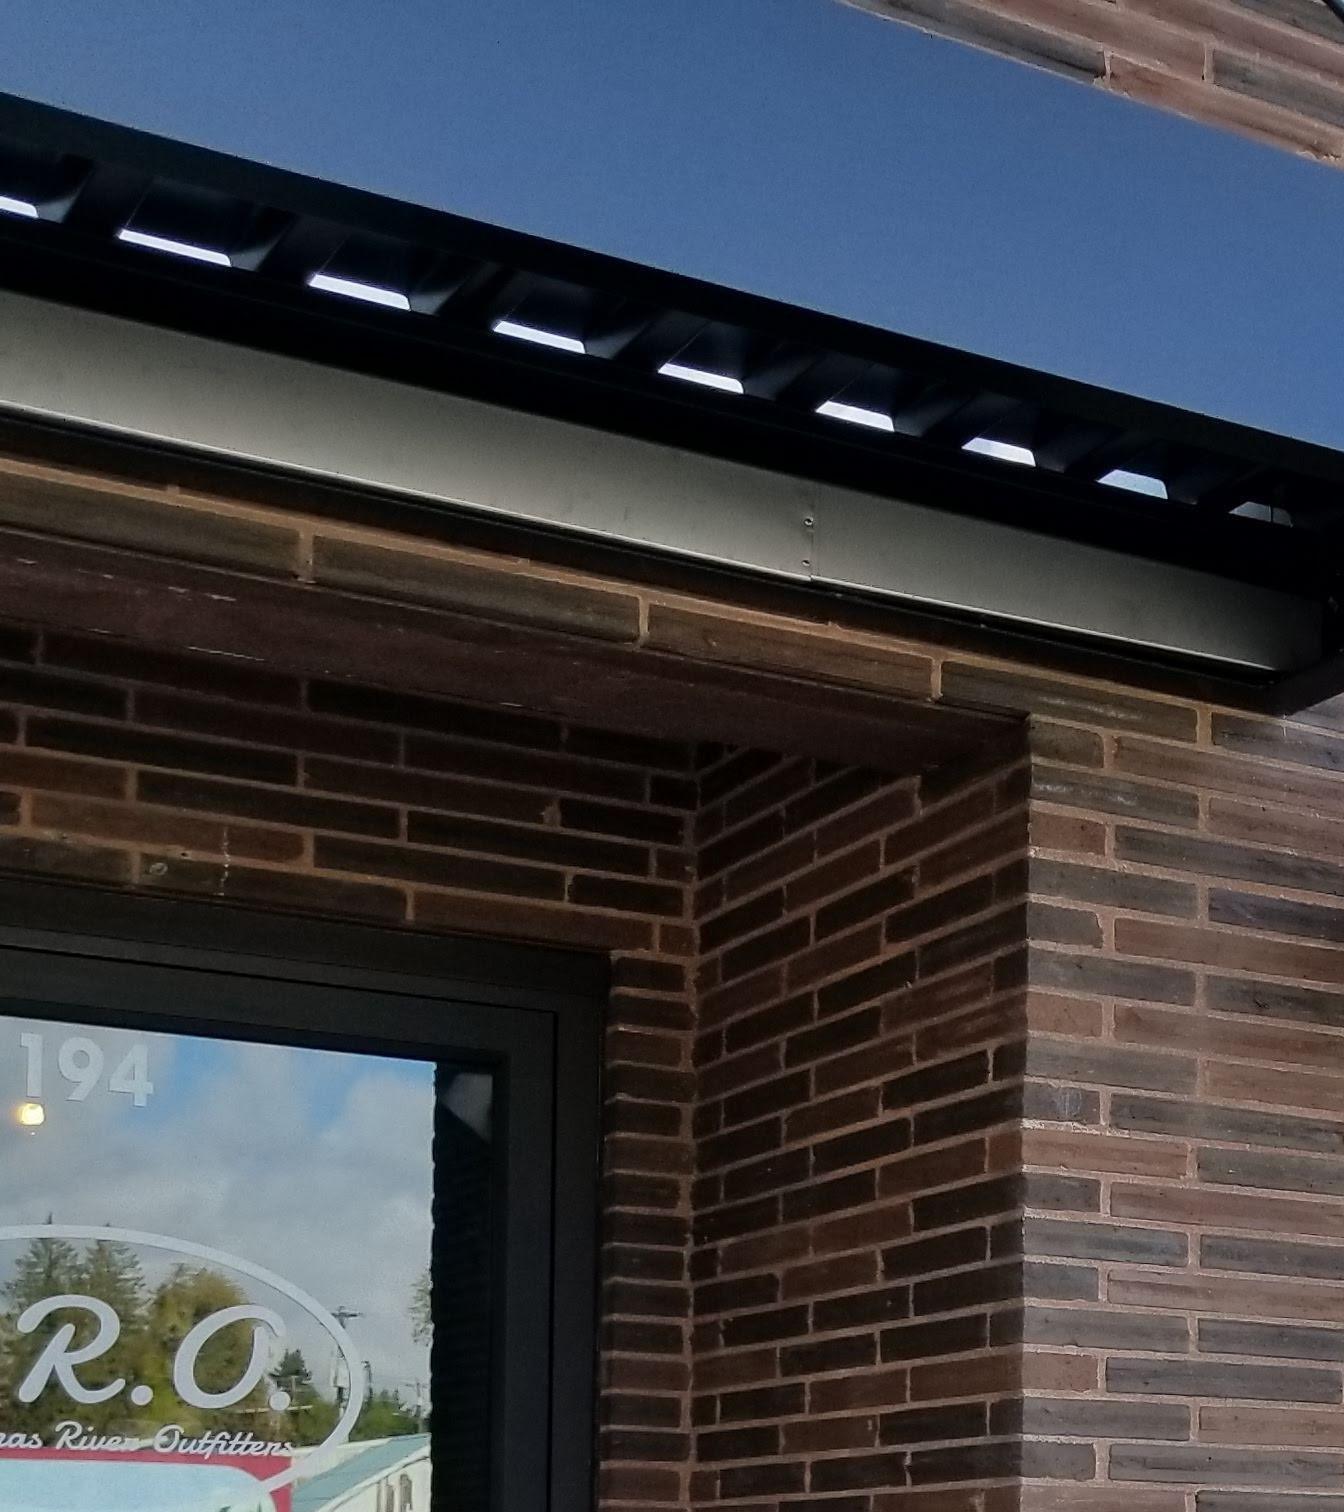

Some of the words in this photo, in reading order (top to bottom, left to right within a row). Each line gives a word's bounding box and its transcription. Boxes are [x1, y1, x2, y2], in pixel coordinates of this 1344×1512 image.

[20, 1032, 154, 1107] 194
[54, 1420, 142, 1451] River
[152, 1424, 294, 1459] Outfitters
